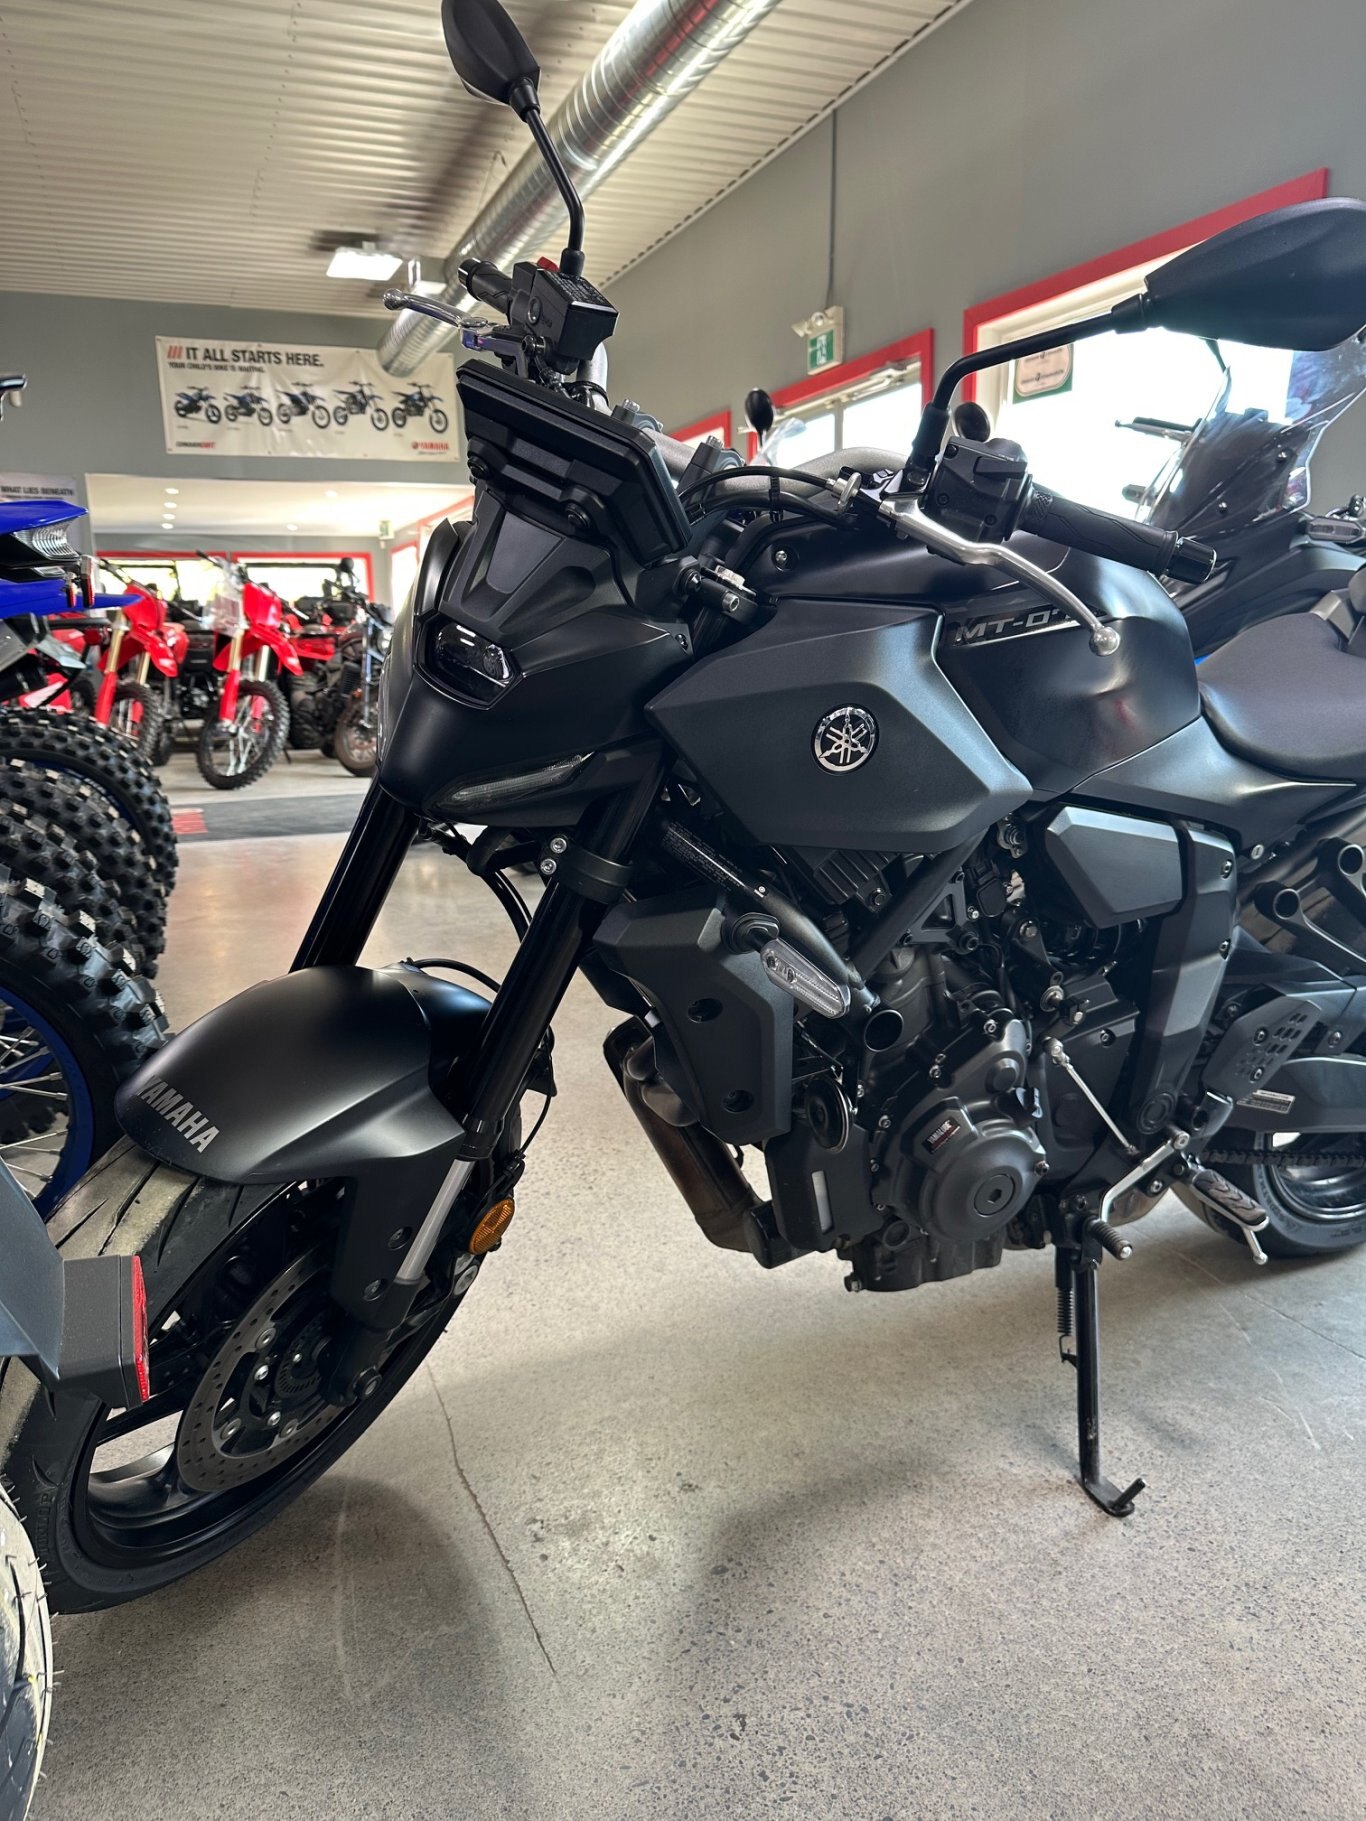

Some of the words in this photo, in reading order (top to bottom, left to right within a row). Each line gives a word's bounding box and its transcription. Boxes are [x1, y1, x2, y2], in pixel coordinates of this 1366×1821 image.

[186, 347, 198, 360] IT
[202, 348, 229, 363] ALL
[231, 349, 282, 365] STARTS
[286, 352, 325, 367] HERE.
[418, 441, 449, 450] YAMAHA
[22, 486, 39, 494] LIES
[135, 1073, 220, 1154] YAMAHA
